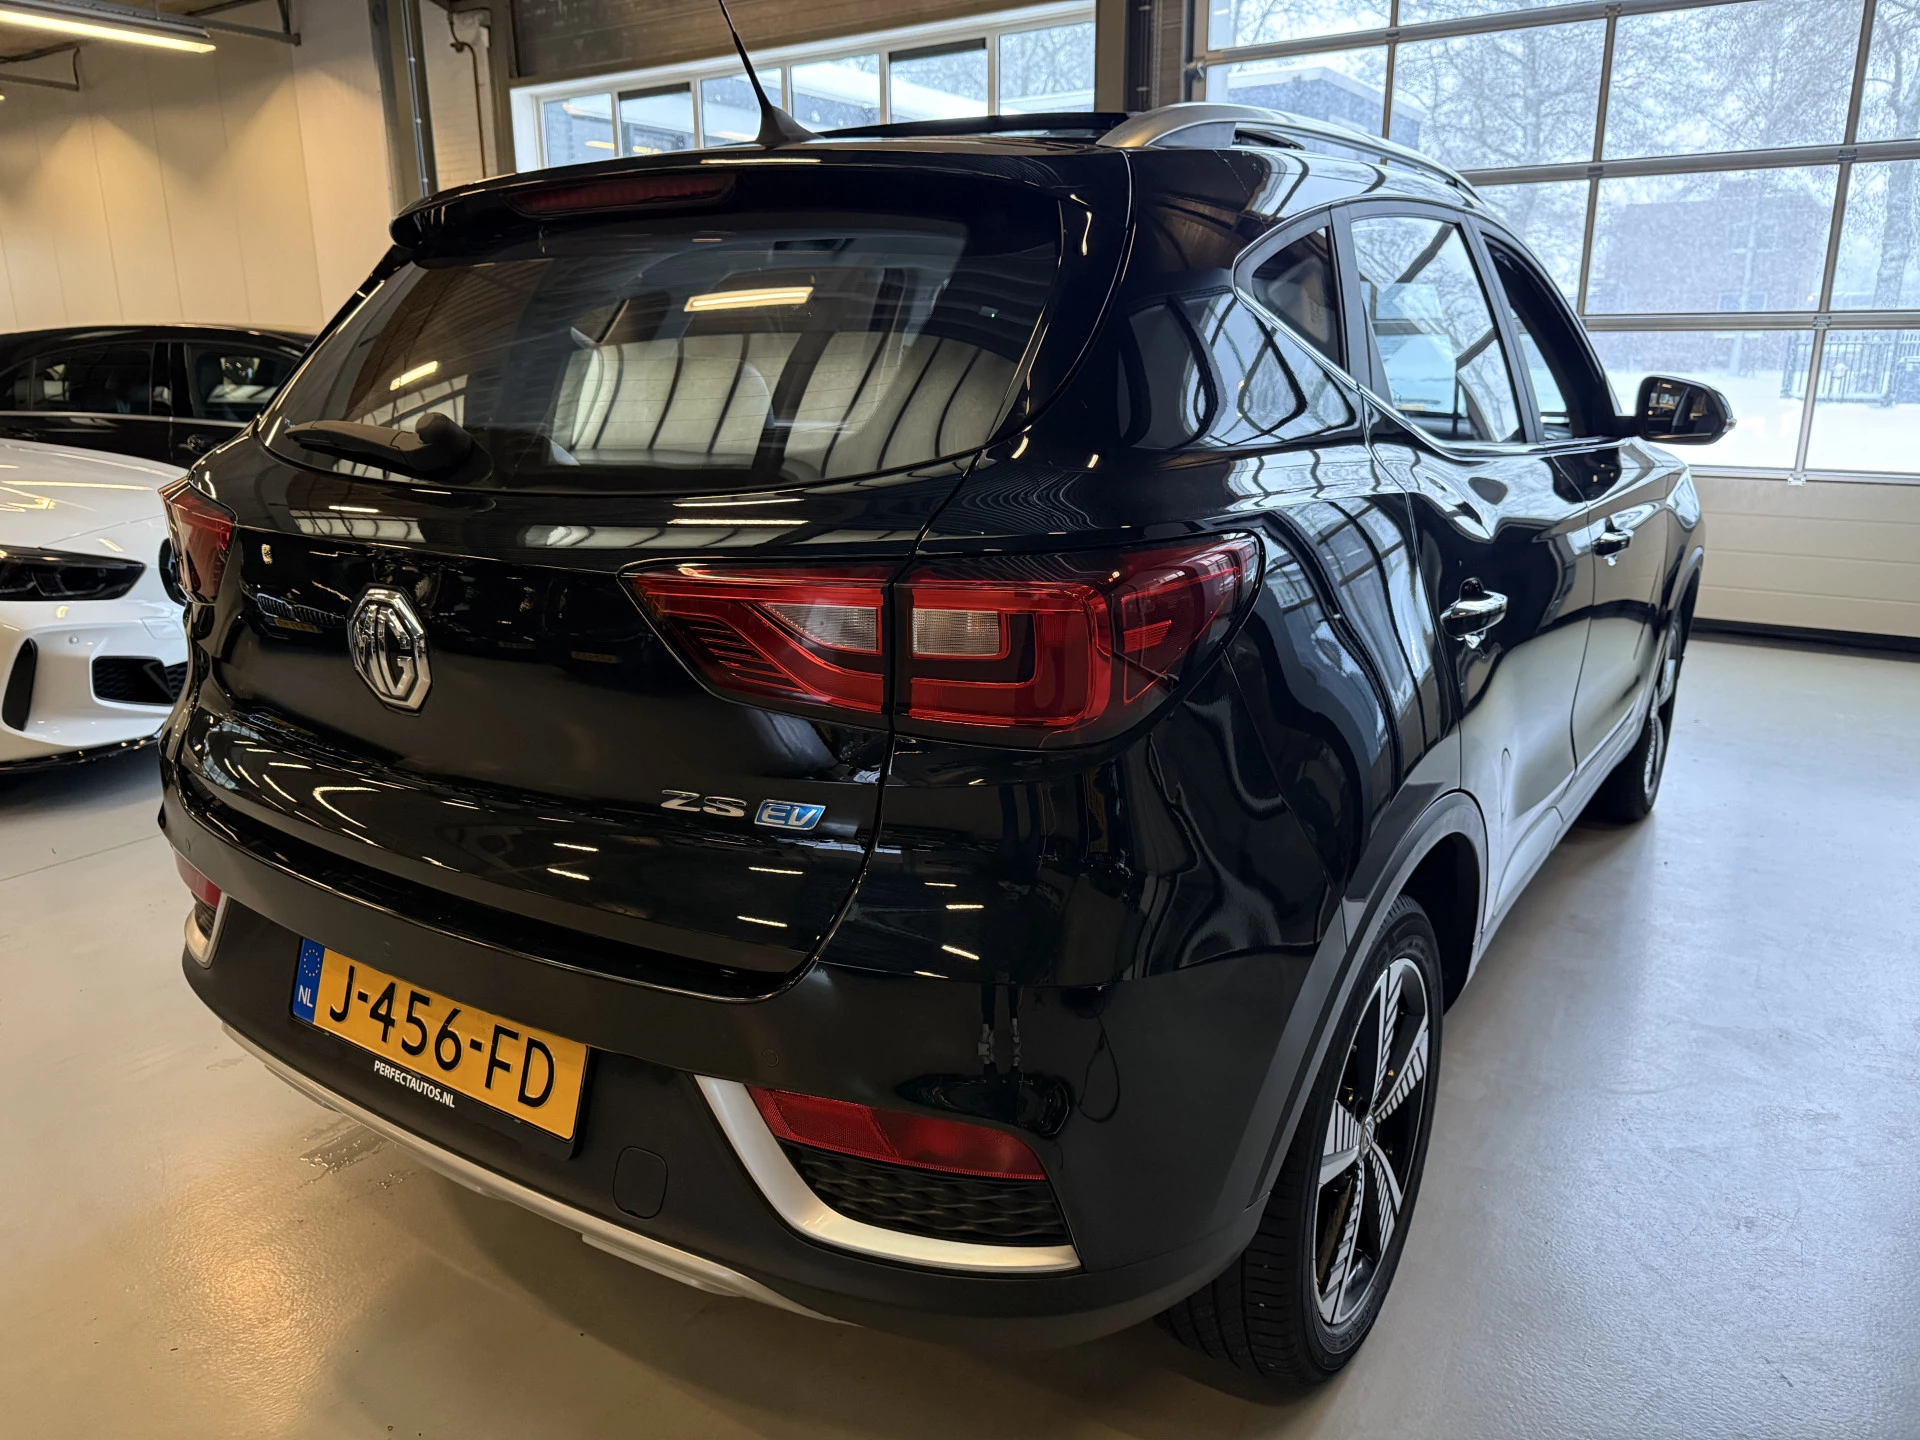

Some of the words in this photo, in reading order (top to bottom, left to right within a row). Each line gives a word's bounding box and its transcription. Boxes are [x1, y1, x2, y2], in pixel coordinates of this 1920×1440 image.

[354, 603, 416, 700] MG
[660, 789, 747, 817] ZS
[760, 803, 818, 826] EV
[298, 985, 314, 1008] NL
[329, 964, 556, 1109] J-456-FD
[373, 1060, 456, 1108] PERFECTAUTOS.NL
